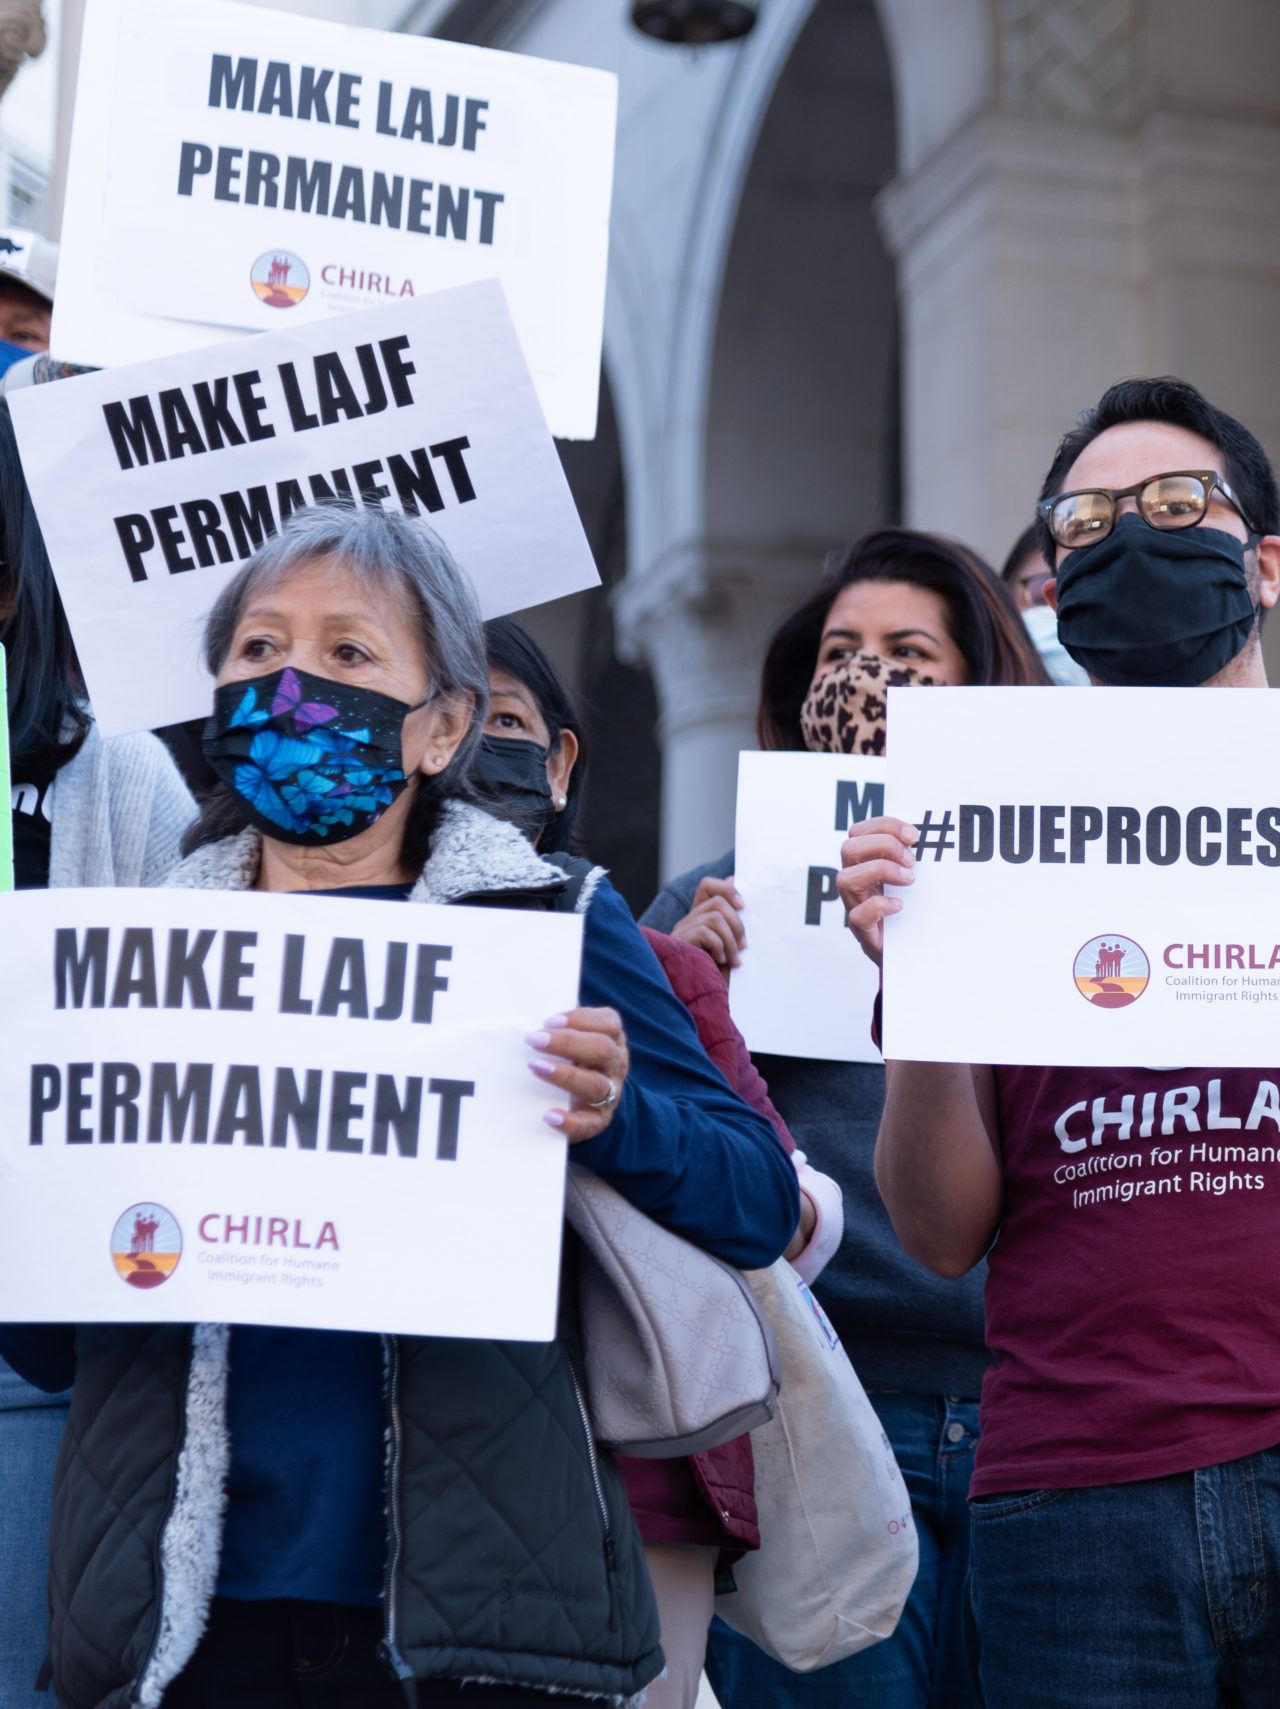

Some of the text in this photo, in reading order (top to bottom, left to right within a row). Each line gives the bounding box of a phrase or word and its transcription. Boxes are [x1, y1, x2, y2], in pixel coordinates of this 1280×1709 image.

[208, 53, 489, 152] MAKE LAJF
[177, 141, 504, 245] PERMANENT
[321, 264, 415, 297] CHIRLA
[102, 334, 417, 470] MAKE LAJF
[53, 927, 453, 1024] MAKE LAJF
[1165, 975, 1218, 986] Coalition
[1222, 975, 1238, 986] for
[1176, 990, 1278, 1003] Immigrant Rights
[28, 1062, 475, 1161] PERMANENT
[1053, 1153, 1142, 1184] Coalition
[1150, 1147, 1183, 1166] for
[1073, 1170, 1265, 1209] Immigrant Rights
[198, 1213, 340, 1251] CHIRLA
[198, 1251, 340, 1271] Coalition for Humane
[207, 1269, 323, 1288] Immigrant Rights
